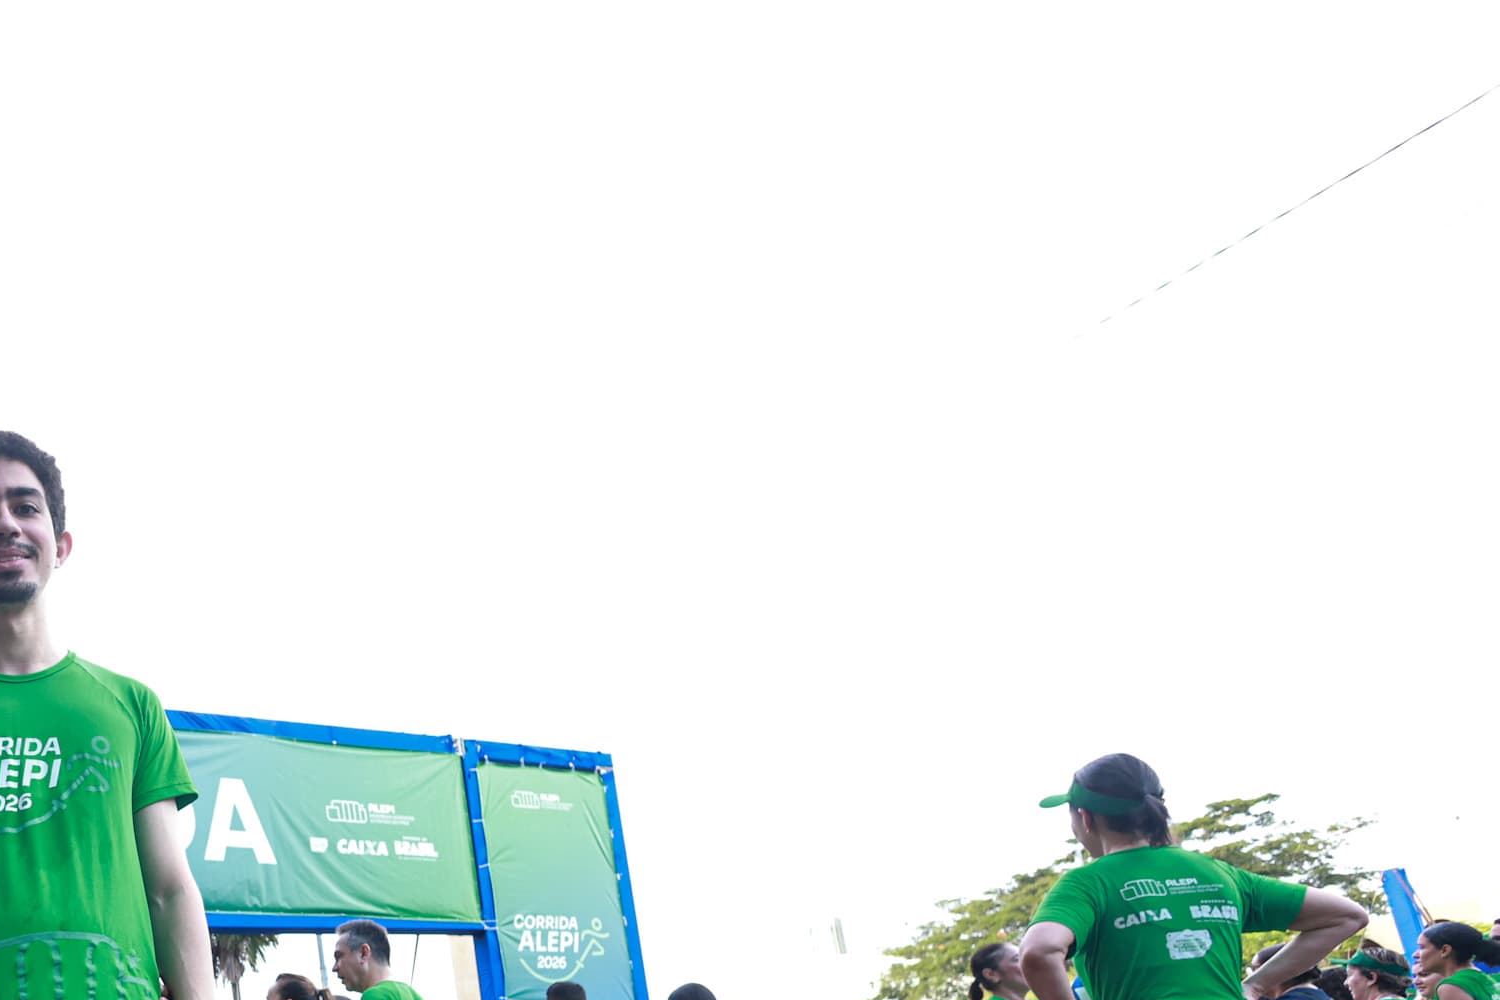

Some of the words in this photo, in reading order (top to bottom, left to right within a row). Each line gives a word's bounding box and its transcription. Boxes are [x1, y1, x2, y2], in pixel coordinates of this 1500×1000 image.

[336, 838, 389, 857] CAIXA
[513, 914, 579, 931] CORRIDA
[1113, 908, 1173, 930] CAIXA
[518, 930, 580, 953] ALEPI
[537, 955, 568, 970] 2026
